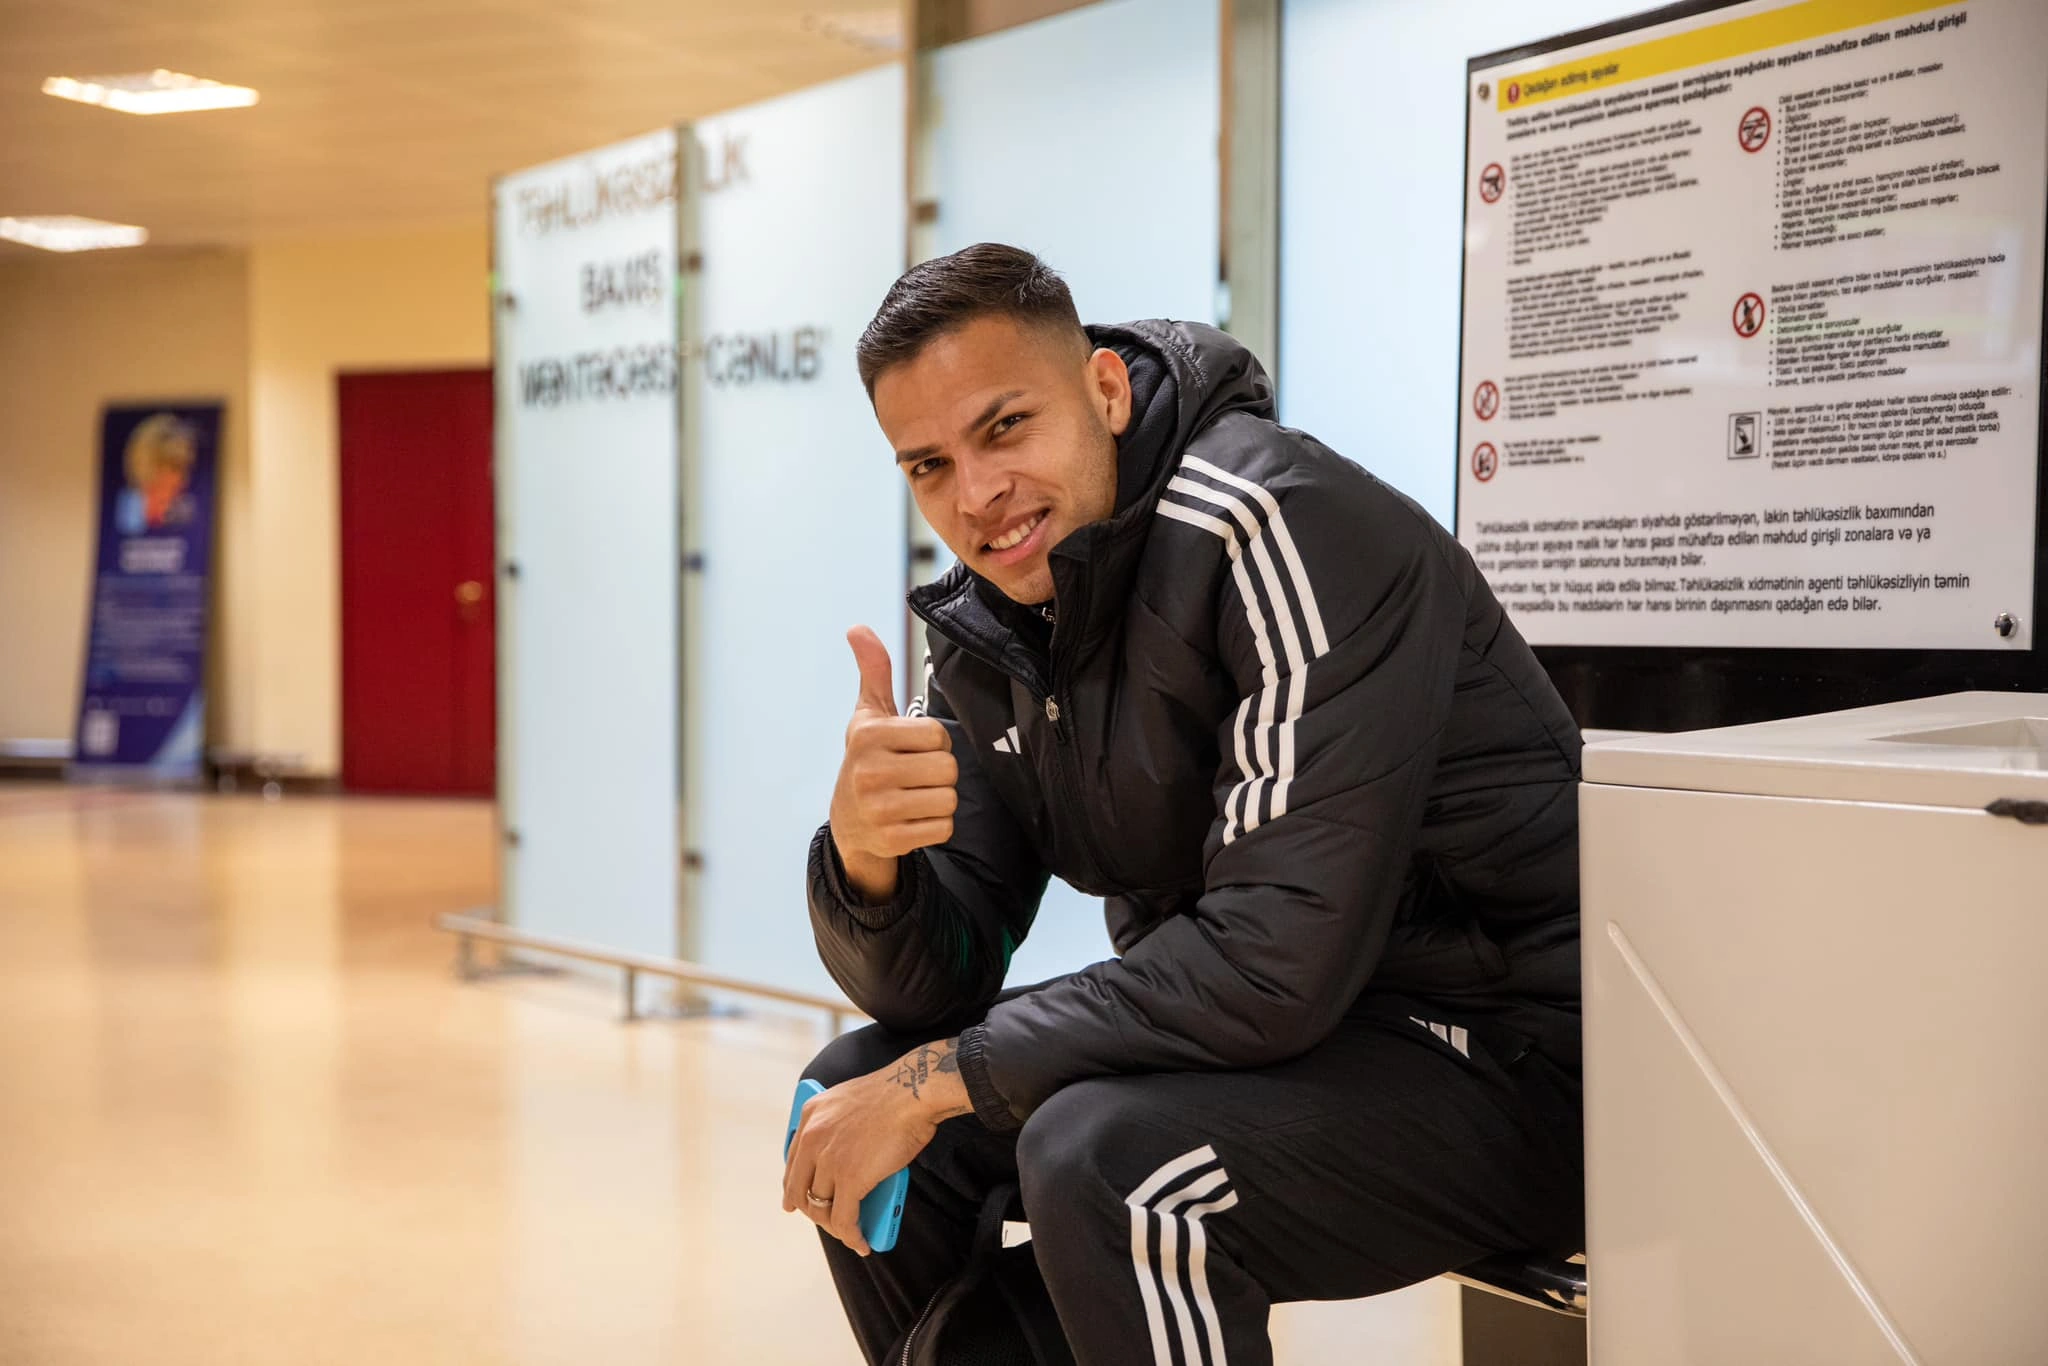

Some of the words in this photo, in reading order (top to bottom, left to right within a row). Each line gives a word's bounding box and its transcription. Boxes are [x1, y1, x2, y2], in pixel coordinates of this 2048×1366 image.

[1814, 40, 1858, 57] mühafizə
[1860, 32, 1890, 47] edilən
[1894, 19, 1935, 39] məhdud
[1937, 11, 1967, 32] girişli
[1640, 514, 1681, 530] siyahıda
[1684, 512, 1760, 529] göstərilməyən,
[1763, 510, 1789, 524] lakin
[1792, 505, 1861, 523] təhlükəsizlik
[1864, 503, 1935, 520] baxımından
[1678, 532, 1724, 547] mühafizə
[1727, 531, 1759, 546] edilən
[1763, 529, 1807, 544] məhdud
[1810, 528, 1841, 545] girişli
[1844, 527, 1894, 542] zonalara
[1897, 528, 1913, 540] və
[1916, 528, 1931, 542] ya
[1680, 552, 1706, 566] bilər.
[1747, 577, 1805, 591] xidmətinin
[1807, 576, 1843, 593] agenti
[1846, 574, 1930, 592] təhlükəsizliyin
[1933, 573, 1970, 588] təmin
[1709, 598, 1773, 614] daşınmasını
[1775, 596, 1824, 614] qadağan
[1826, 596, 1850, 611] edə
[1851, 596, 1882, 611] bilər.
